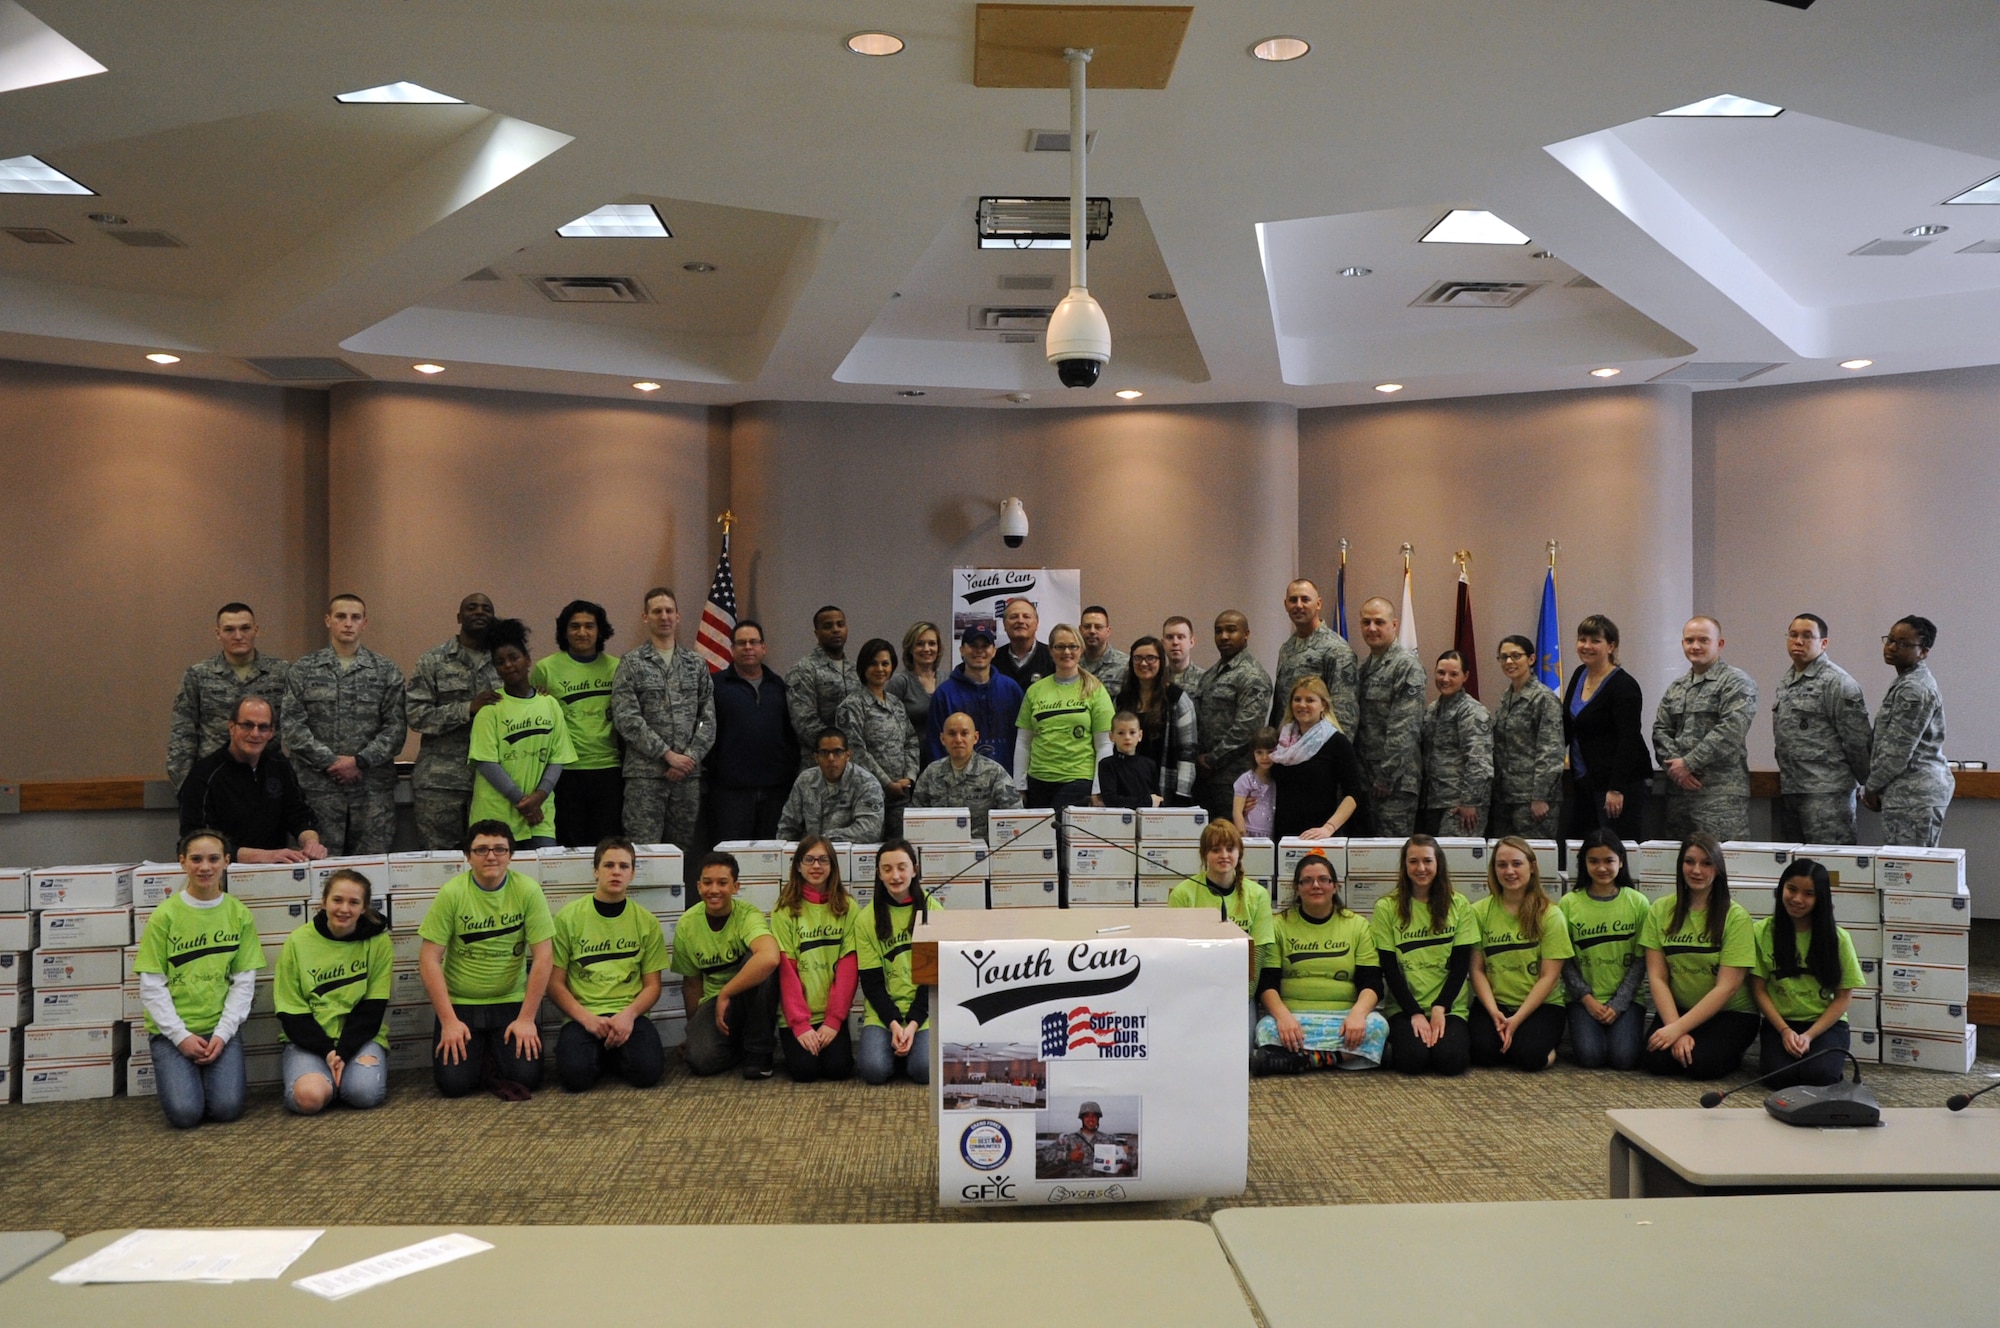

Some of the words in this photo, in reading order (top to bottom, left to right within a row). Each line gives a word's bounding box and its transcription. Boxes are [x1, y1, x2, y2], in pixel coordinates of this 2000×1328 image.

[962, 573, 1000, 590] Youth
[1005, 571, 1031, 584] Can
[559, 681, 590, 693] Youth
[594, 679, 613, 689] Can
[1036, 700, 1062, 711] Youth
[502, 718, 532, 732] Youth
[460, 915, 496, 930] Youth
[501, 913, 523, 925] Can
[1572, 922, 1607, 937] Youth
[1613, 920, 1637, 931] Can
[1395, 926, 1428, 940] Youth
[1661, 928, 1693, 943] Youth
[1698, 933, 1713, 943] Ca
[168, 934, 208, 952] Youth
[214, 930, 240, 943] Can
[579, 940, 611, 954] Youth
[617, 938, 637, 949] Can
[1287, 938, 1319, 952] Youth
[1324, 939, 1347, 950] Can
[693, 952, 722, 966] Youth
[960, 948, 1055, 988] Youth
[1067, 943, 1127, 972] Can
[307, 966, 346, 985] Youth
[1090, 1015, 1146, 1030] SUPPORT
[1114, 1030, 1138, 1043] OUR
[1098, 1045, 1146, 1058] TROOPS
[962, 1175, 1016, 1200] GFYC
